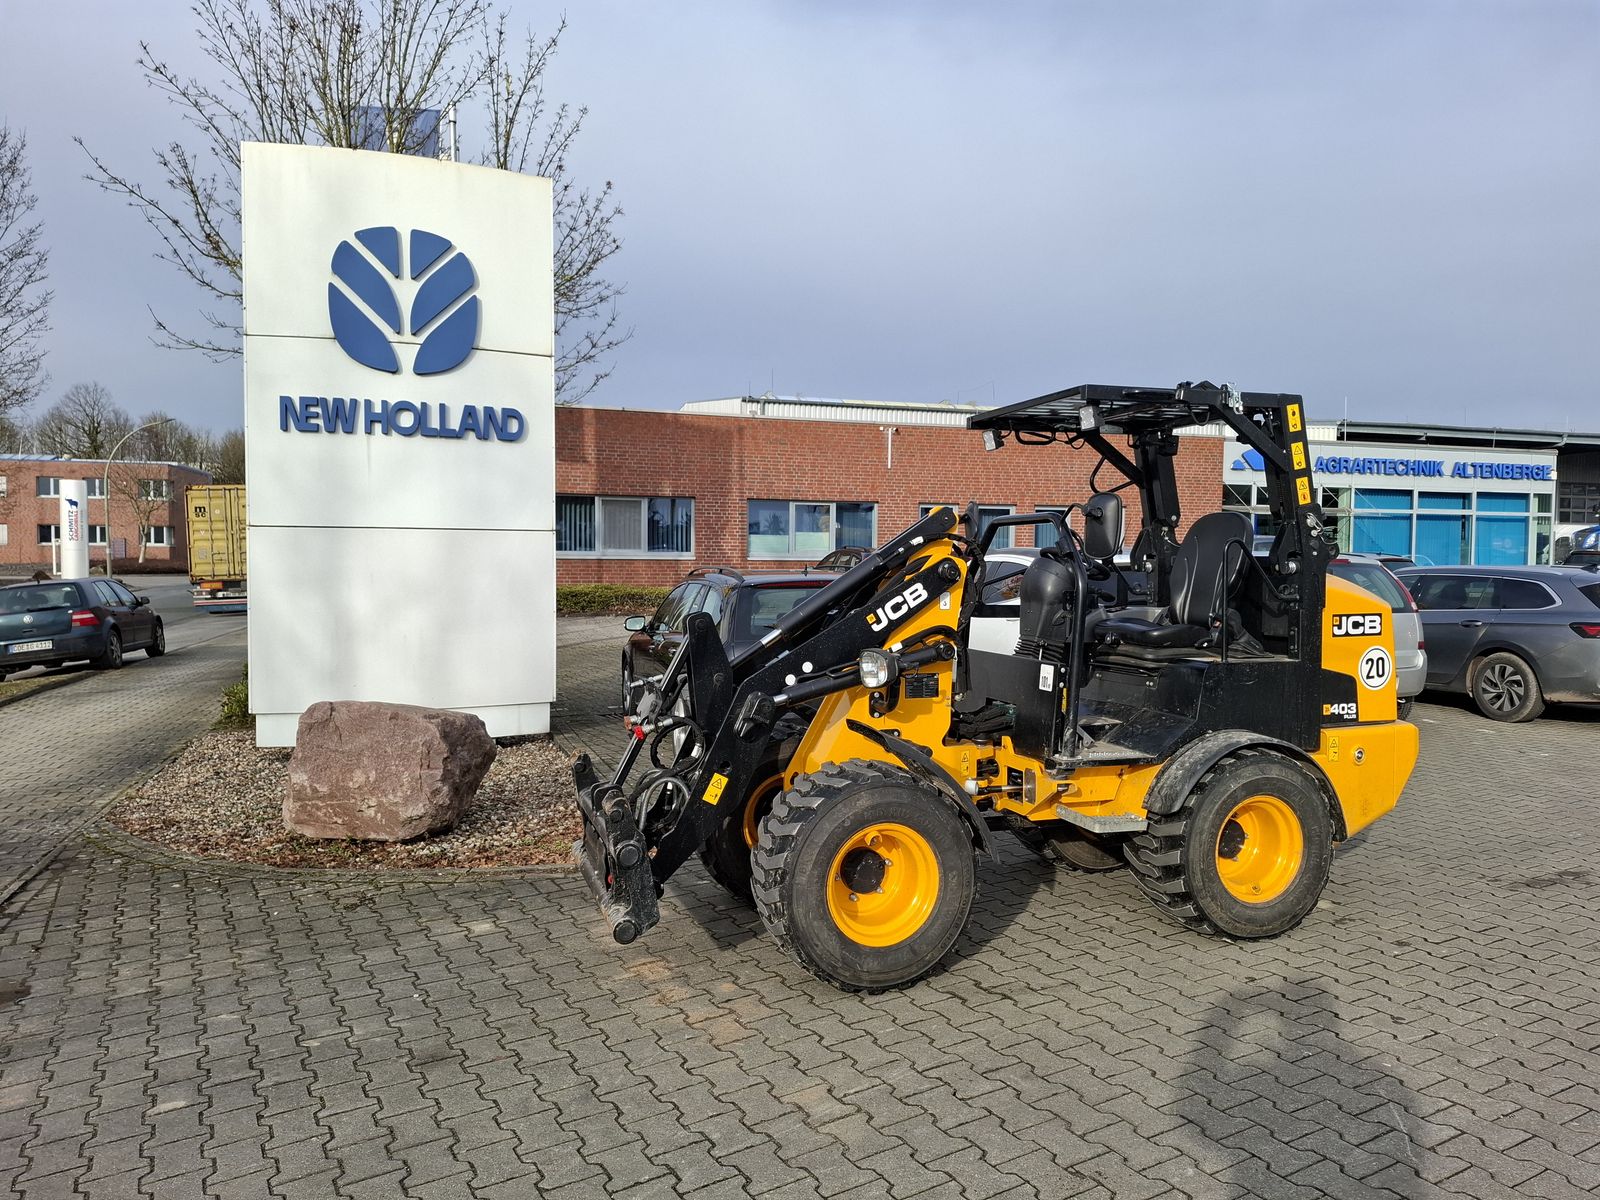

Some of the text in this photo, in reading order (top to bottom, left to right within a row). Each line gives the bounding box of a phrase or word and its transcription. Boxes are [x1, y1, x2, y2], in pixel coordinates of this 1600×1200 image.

[279, 395, 525, 442] NEW HOLLAND
[1313, 456, 1553, 481] AGRARTECHNIK ALTENBERGE
[867, 582, 929, 632] JCB
[1332, 614, 1382, 636] JCB
[1365, 656, 1386, 680] 20
[1330, 702, 1357, 715] 403
